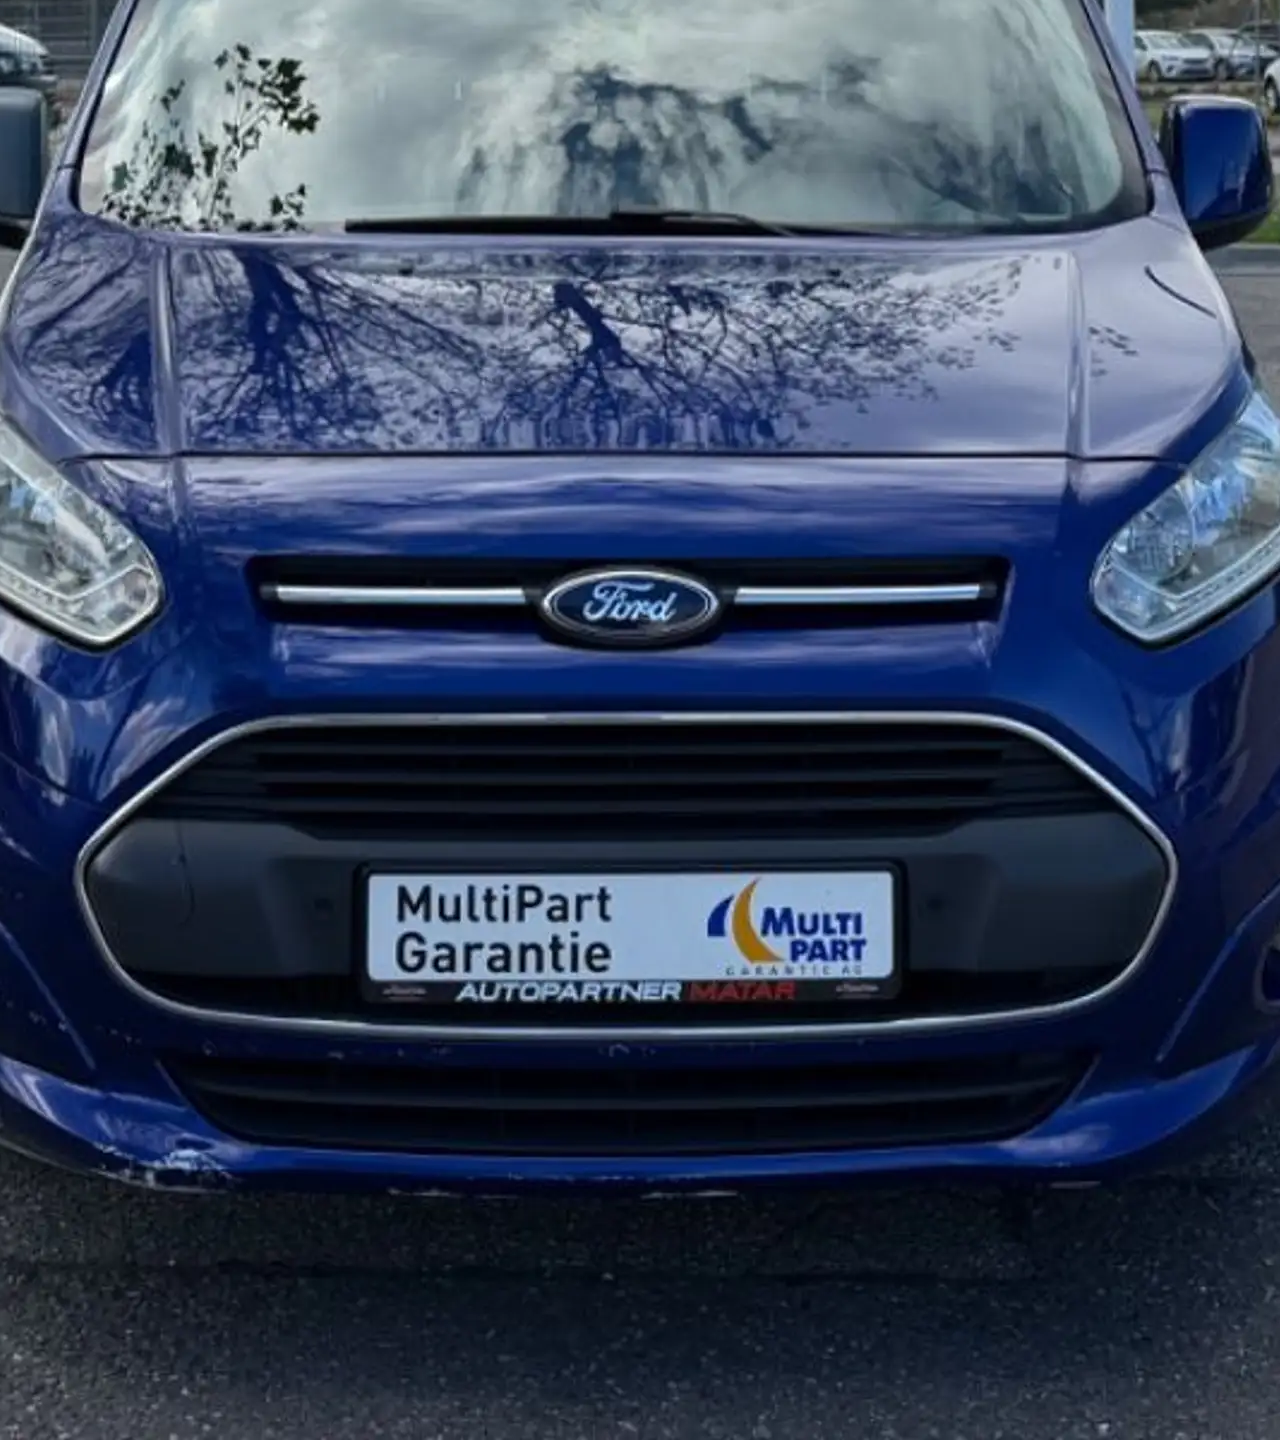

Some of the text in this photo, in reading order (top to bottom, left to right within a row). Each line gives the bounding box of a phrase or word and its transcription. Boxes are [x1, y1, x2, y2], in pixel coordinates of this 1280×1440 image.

[582, 580, 678, 622] Ford
[396, 884, 612, 923] MultiPart
[761, 906, 863, 937] MULTI
[396, 930, 612, 974] Garantie
[790, 938, 867, 963] PART
[724, 964, 862, 976] GARANTIE AG
[455, 980, 796, 1003] AUTOPARTNER MATAR
